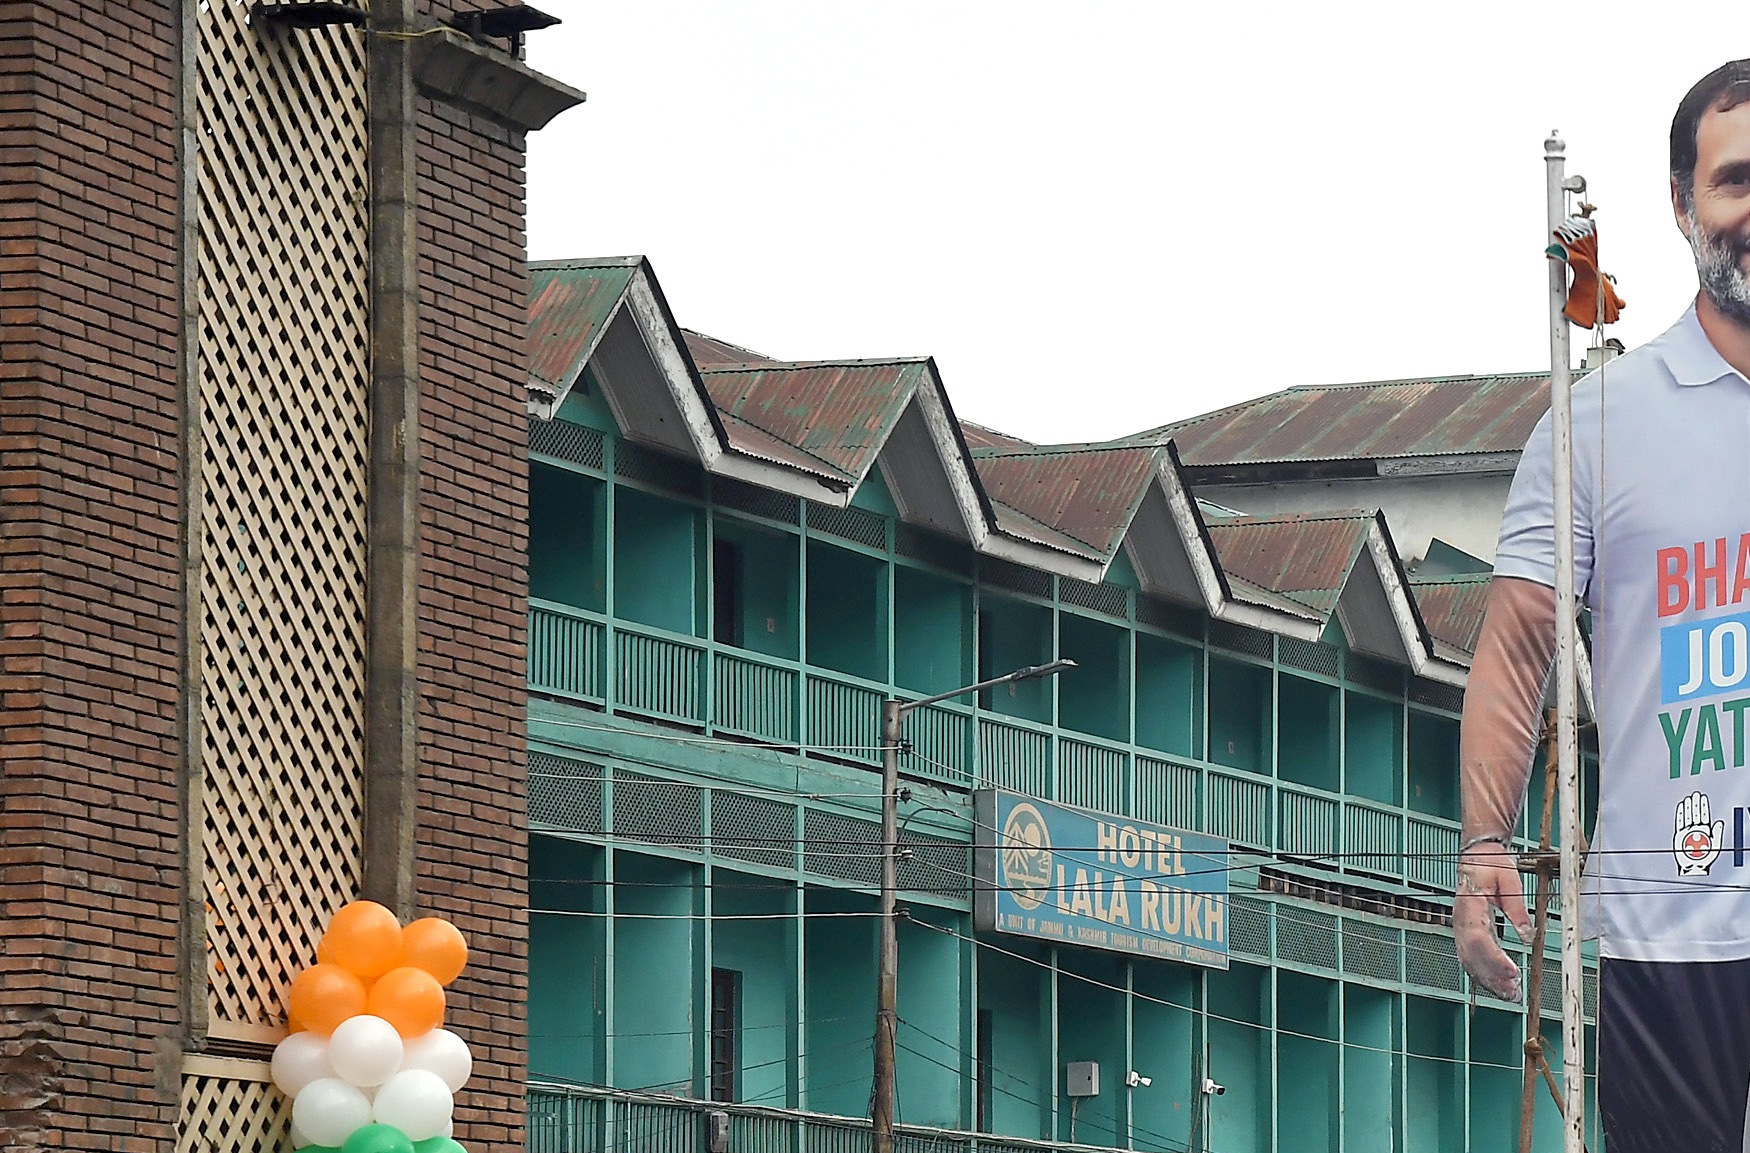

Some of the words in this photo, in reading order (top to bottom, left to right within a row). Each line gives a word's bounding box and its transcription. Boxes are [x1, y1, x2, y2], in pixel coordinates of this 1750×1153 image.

[1097, 821, 1185, 877] HOTEL
[1027, 918, 1035, 931] OF
[1057, 864, 1130, 926] LALA
[1141, 882, 1223, 943] RUKH
